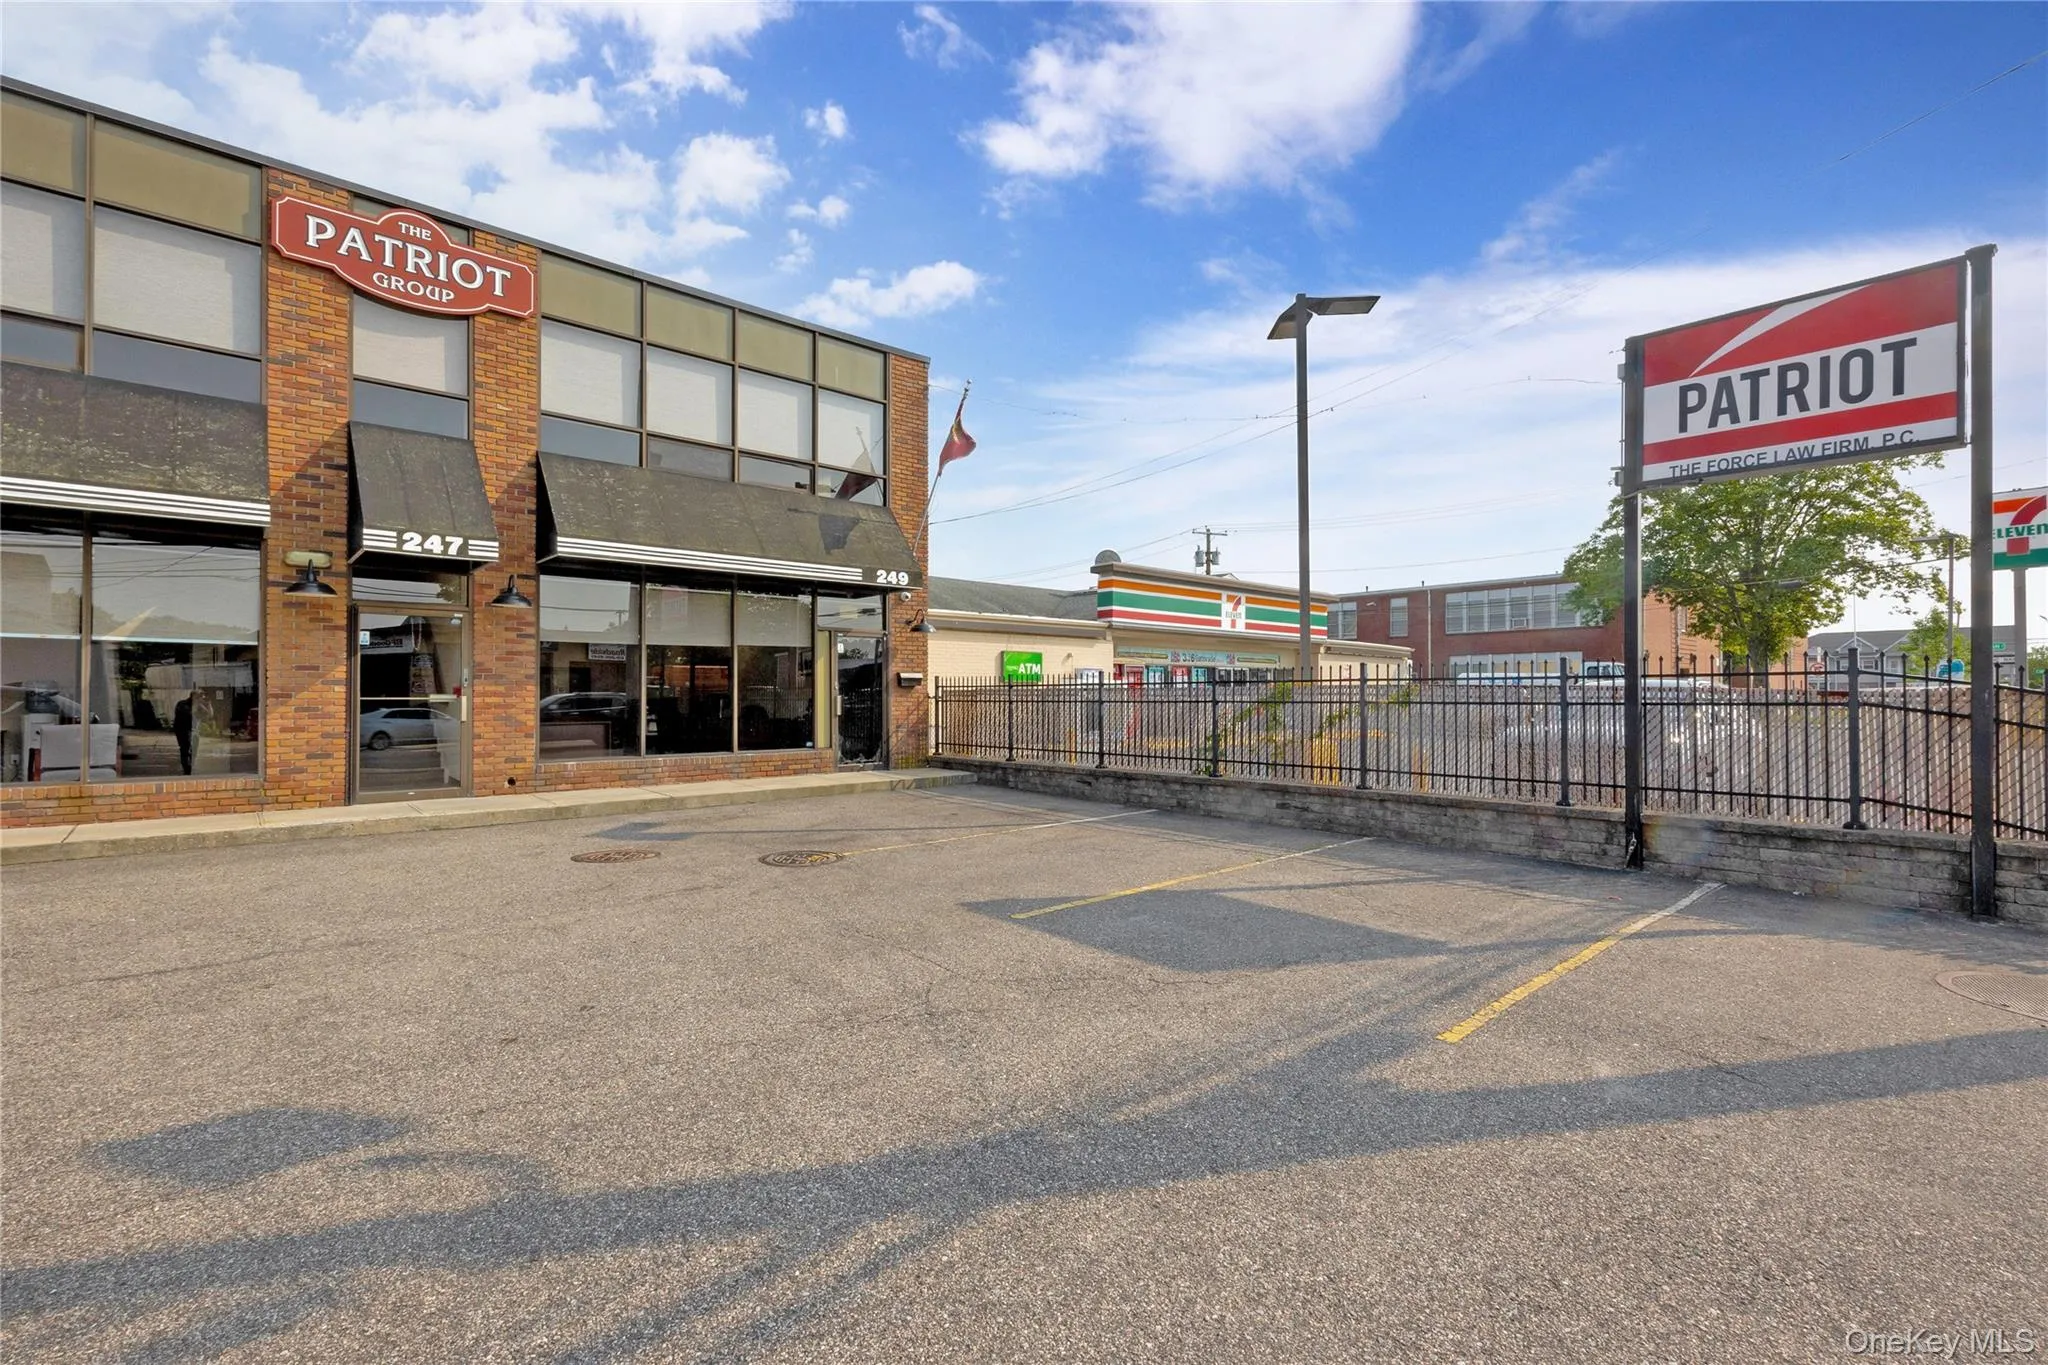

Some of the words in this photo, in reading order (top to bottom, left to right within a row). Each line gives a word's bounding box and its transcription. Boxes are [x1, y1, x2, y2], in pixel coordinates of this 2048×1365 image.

[398, 221, 432, 241] THE
[305, 214, 512, 297] PATRIOT
[372, 272, 455, 304] GROUP
[1678, 337, 1918, 434] PATRIOT
[1669, 462, 1701, 478] THE
[1707, 451, 1768, 473] FORCE
[1774, 444, 1816, 463] LAW
[402, 531, 463, 555] 247
[876, 569, 909, 585] 249
[1018, 662, 1041, 675] ATM
